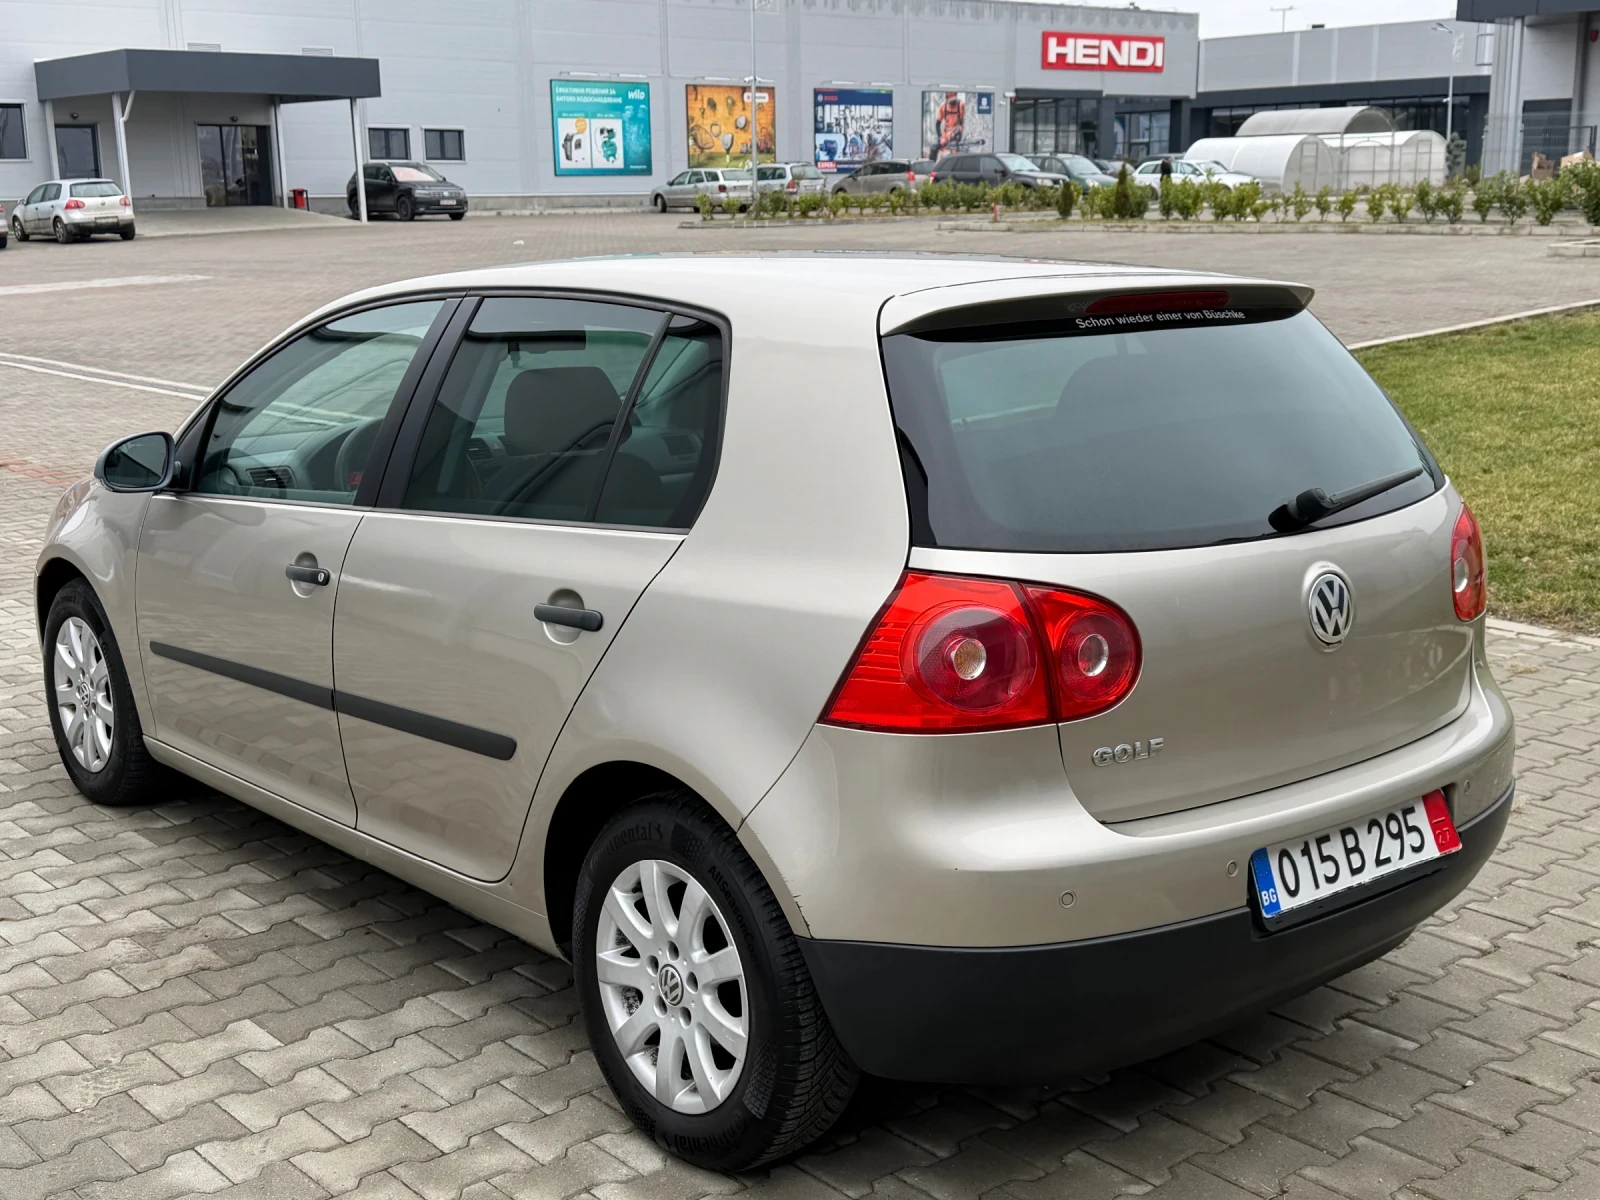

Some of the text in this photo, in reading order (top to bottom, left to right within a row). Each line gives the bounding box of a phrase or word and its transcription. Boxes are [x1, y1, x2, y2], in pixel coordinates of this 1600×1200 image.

[1047, 36, 1164, 67] HENDI
[627, 89, 645, 100] wilo
[1075, 309, 1246, 328] Schon wieder einer von Büschke
[1092, 737, 1164, 767] GOLF
[1262, 889, 1278, 906] BG
